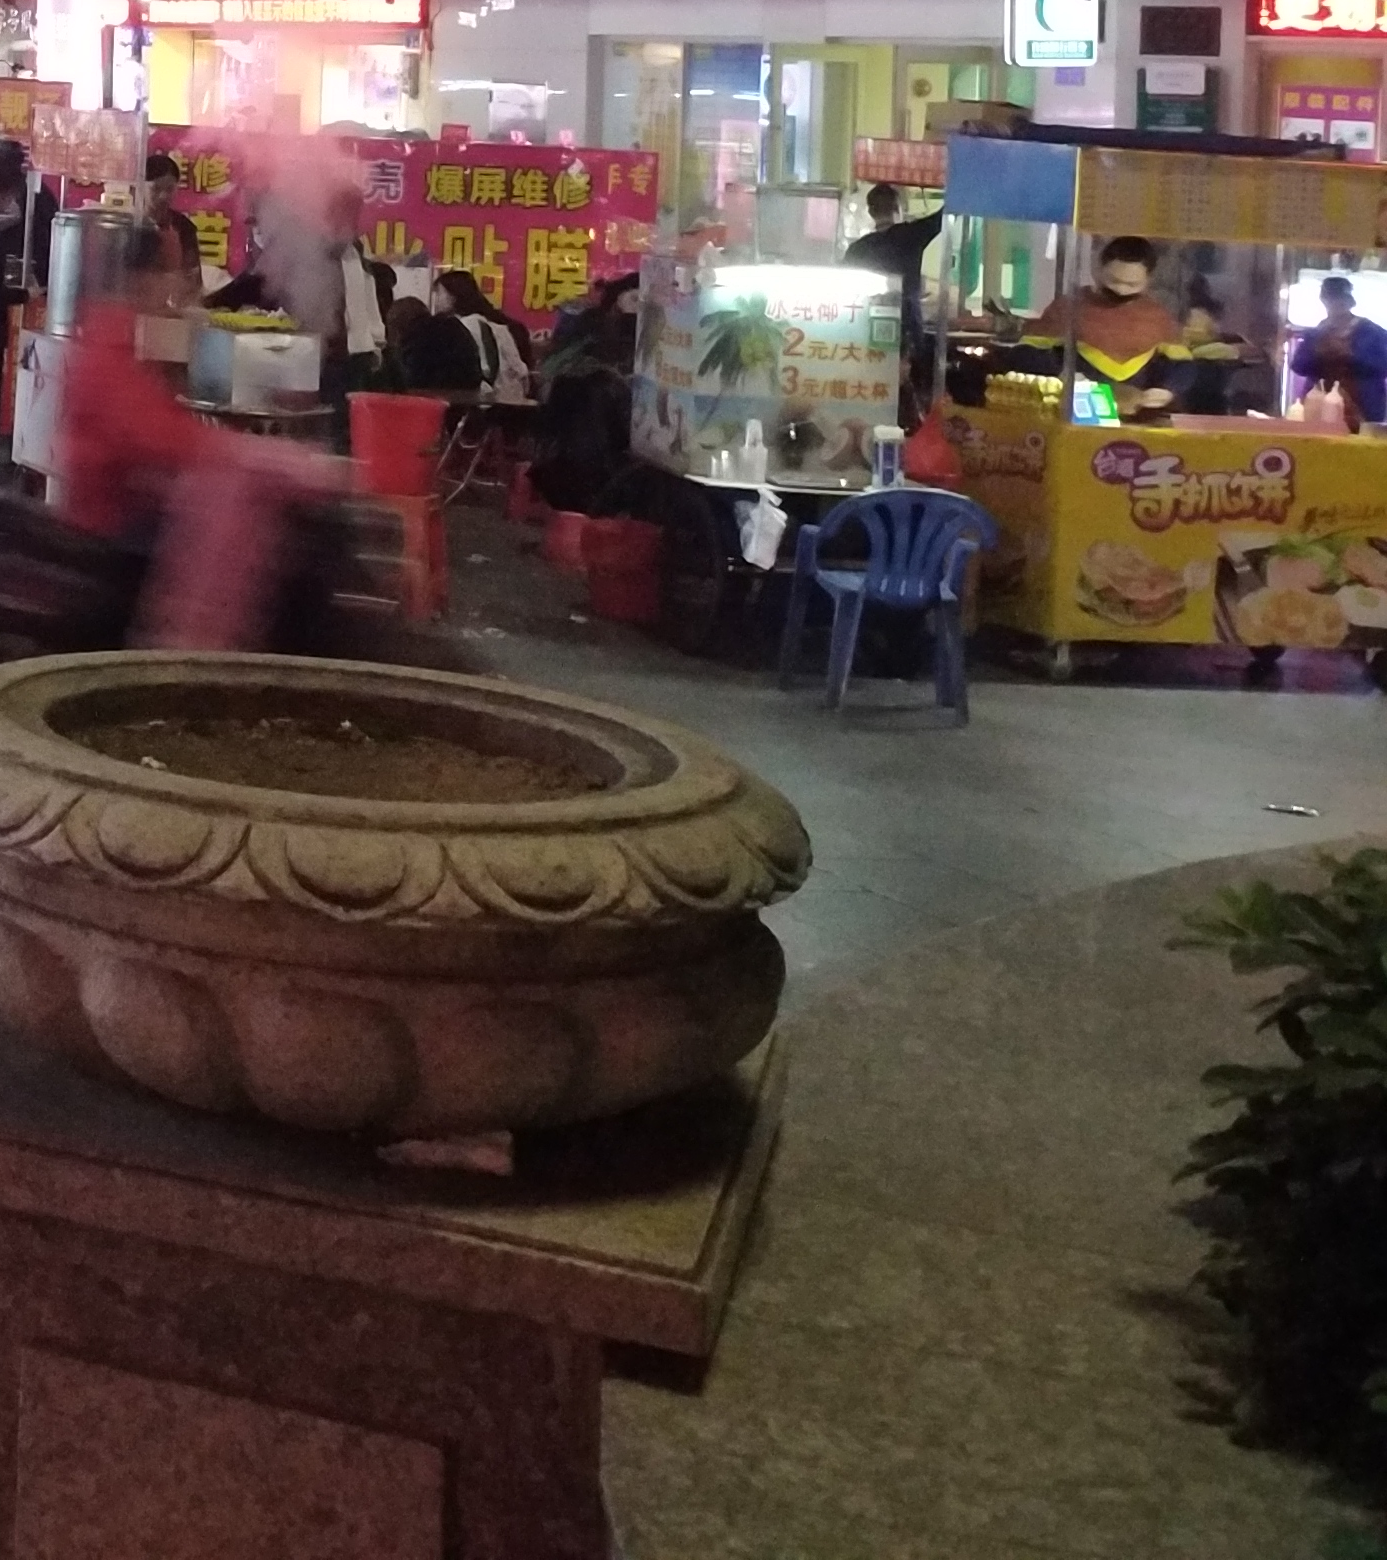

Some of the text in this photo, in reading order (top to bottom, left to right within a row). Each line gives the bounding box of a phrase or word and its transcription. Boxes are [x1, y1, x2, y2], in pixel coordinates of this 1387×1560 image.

[427, 161, 593, 211] 爆屏维修
[1132, 447, 1294, 533] 手抓饼
